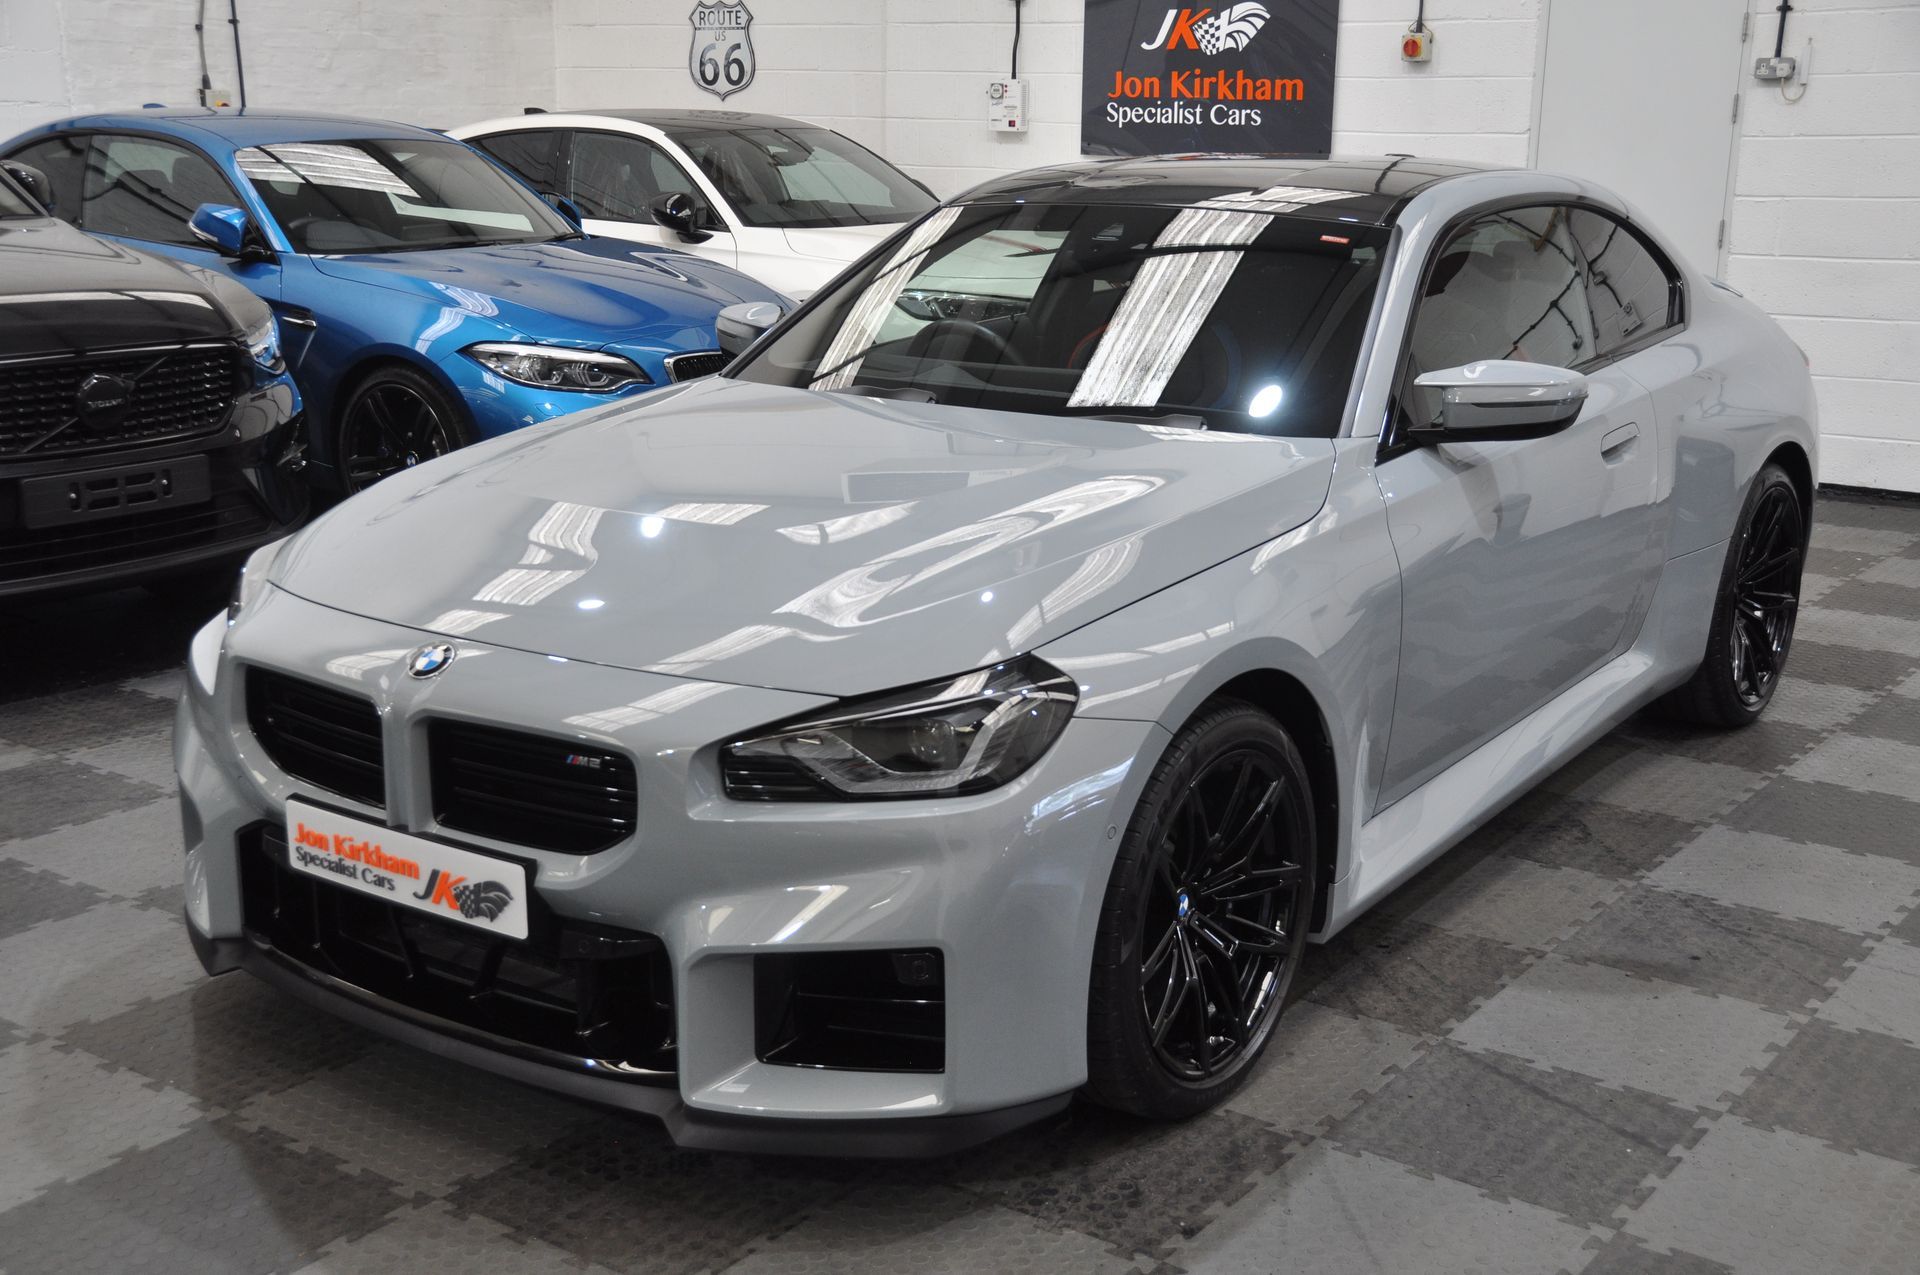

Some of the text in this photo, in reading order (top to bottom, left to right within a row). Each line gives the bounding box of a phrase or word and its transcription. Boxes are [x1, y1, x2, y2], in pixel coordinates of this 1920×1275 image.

[699, 10, 742, 26] ROUTE
[714, 30, 727, 41] US
[699, 42, 745, 86] 66
[1107, 68, 1304, 101] Jon Kirkham
[1106, 101, 1262, 128] Specialist Cars
[294, 822, 420, 880] Jon Kirkham
[295, 846, 396, 892] Specialist Cars
